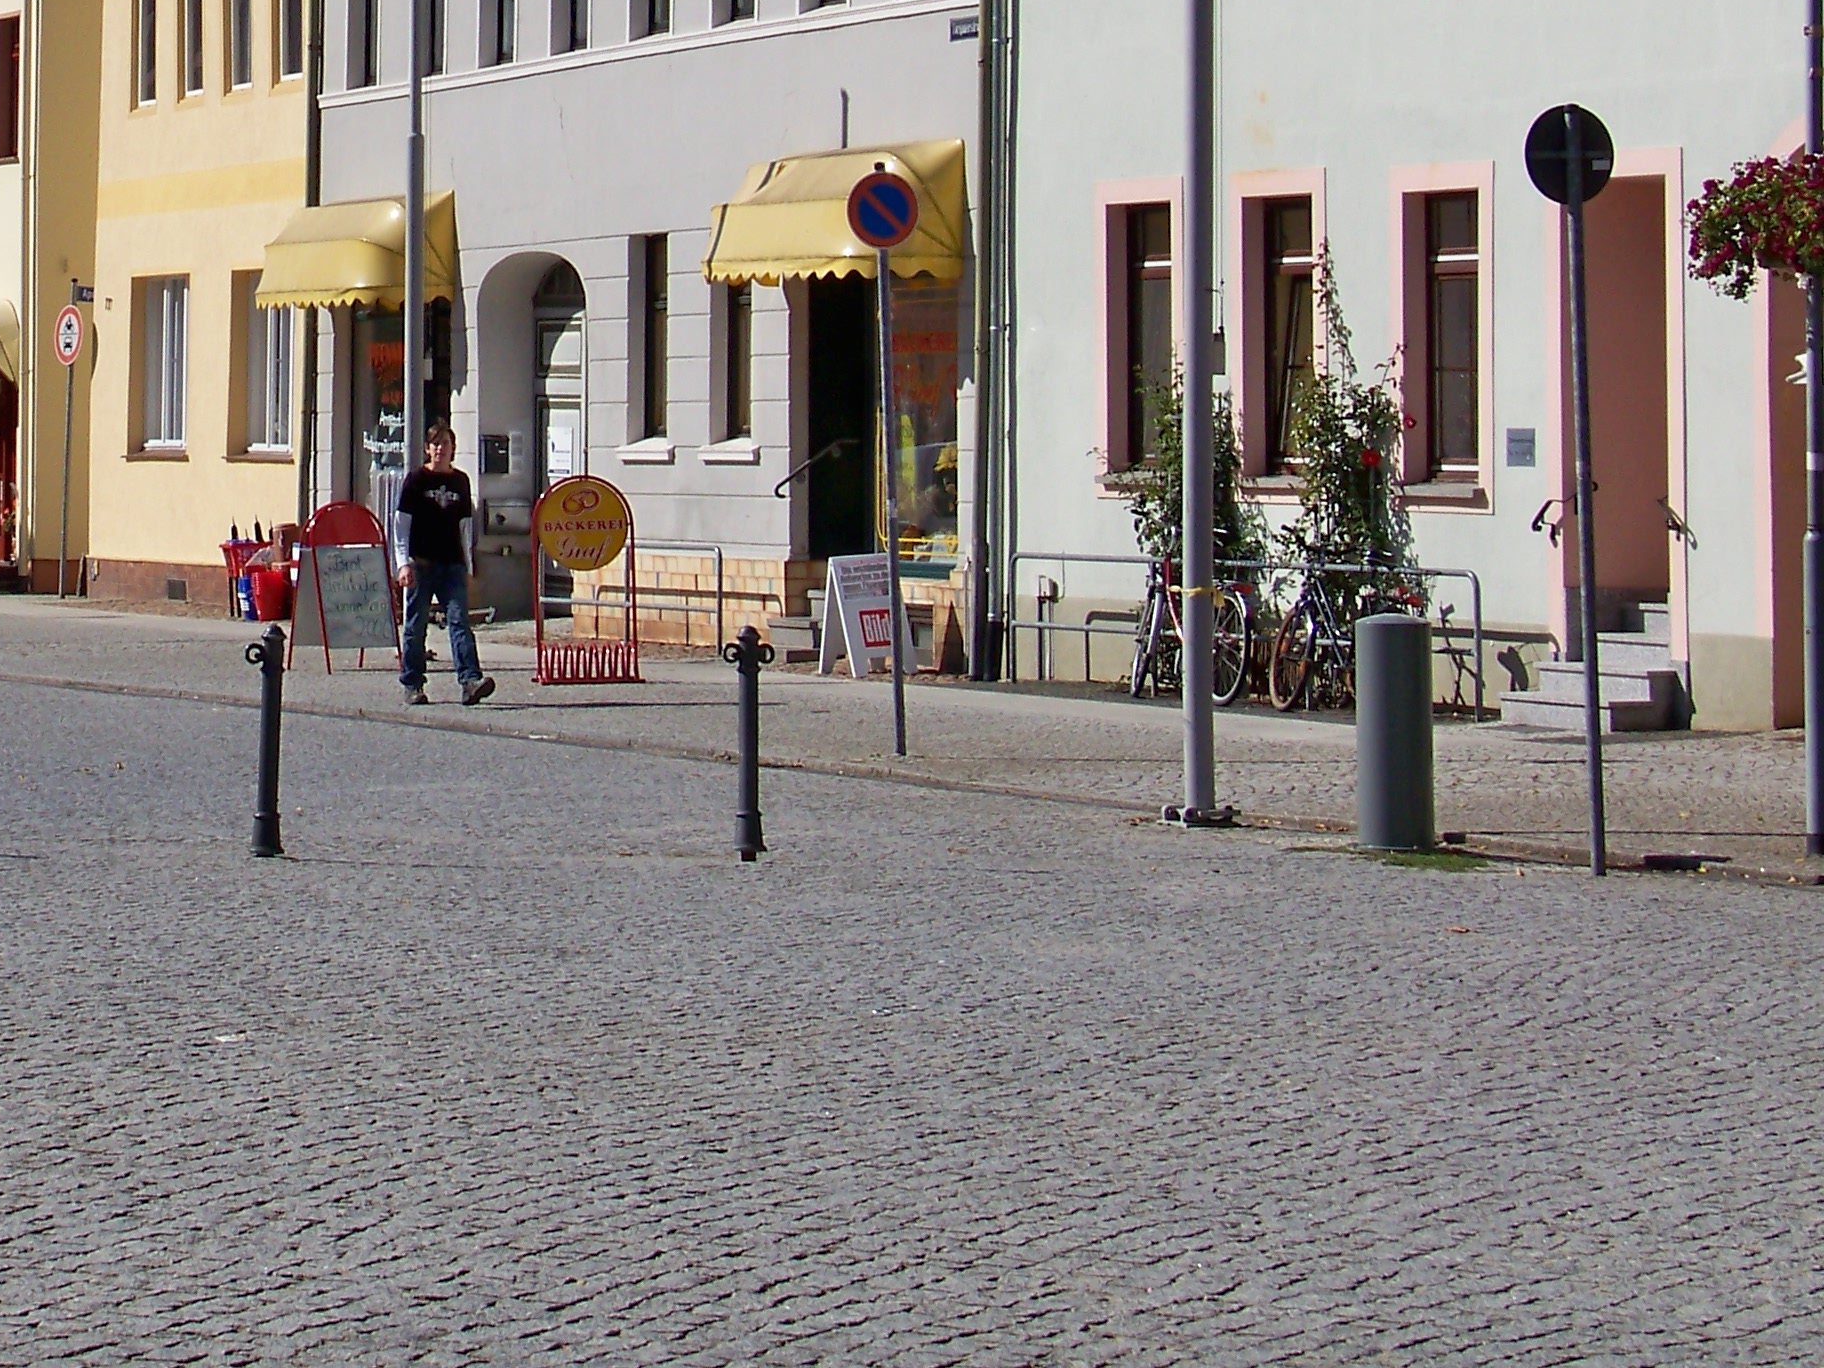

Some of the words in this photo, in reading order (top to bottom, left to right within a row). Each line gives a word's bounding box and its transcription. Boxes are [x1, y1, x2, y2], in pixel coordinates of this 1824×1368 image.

[544, 519, 624, 532] BÄCKEREI
[557, 535, 613, 567] Graf
[862, 613, 892, 643] Bild
